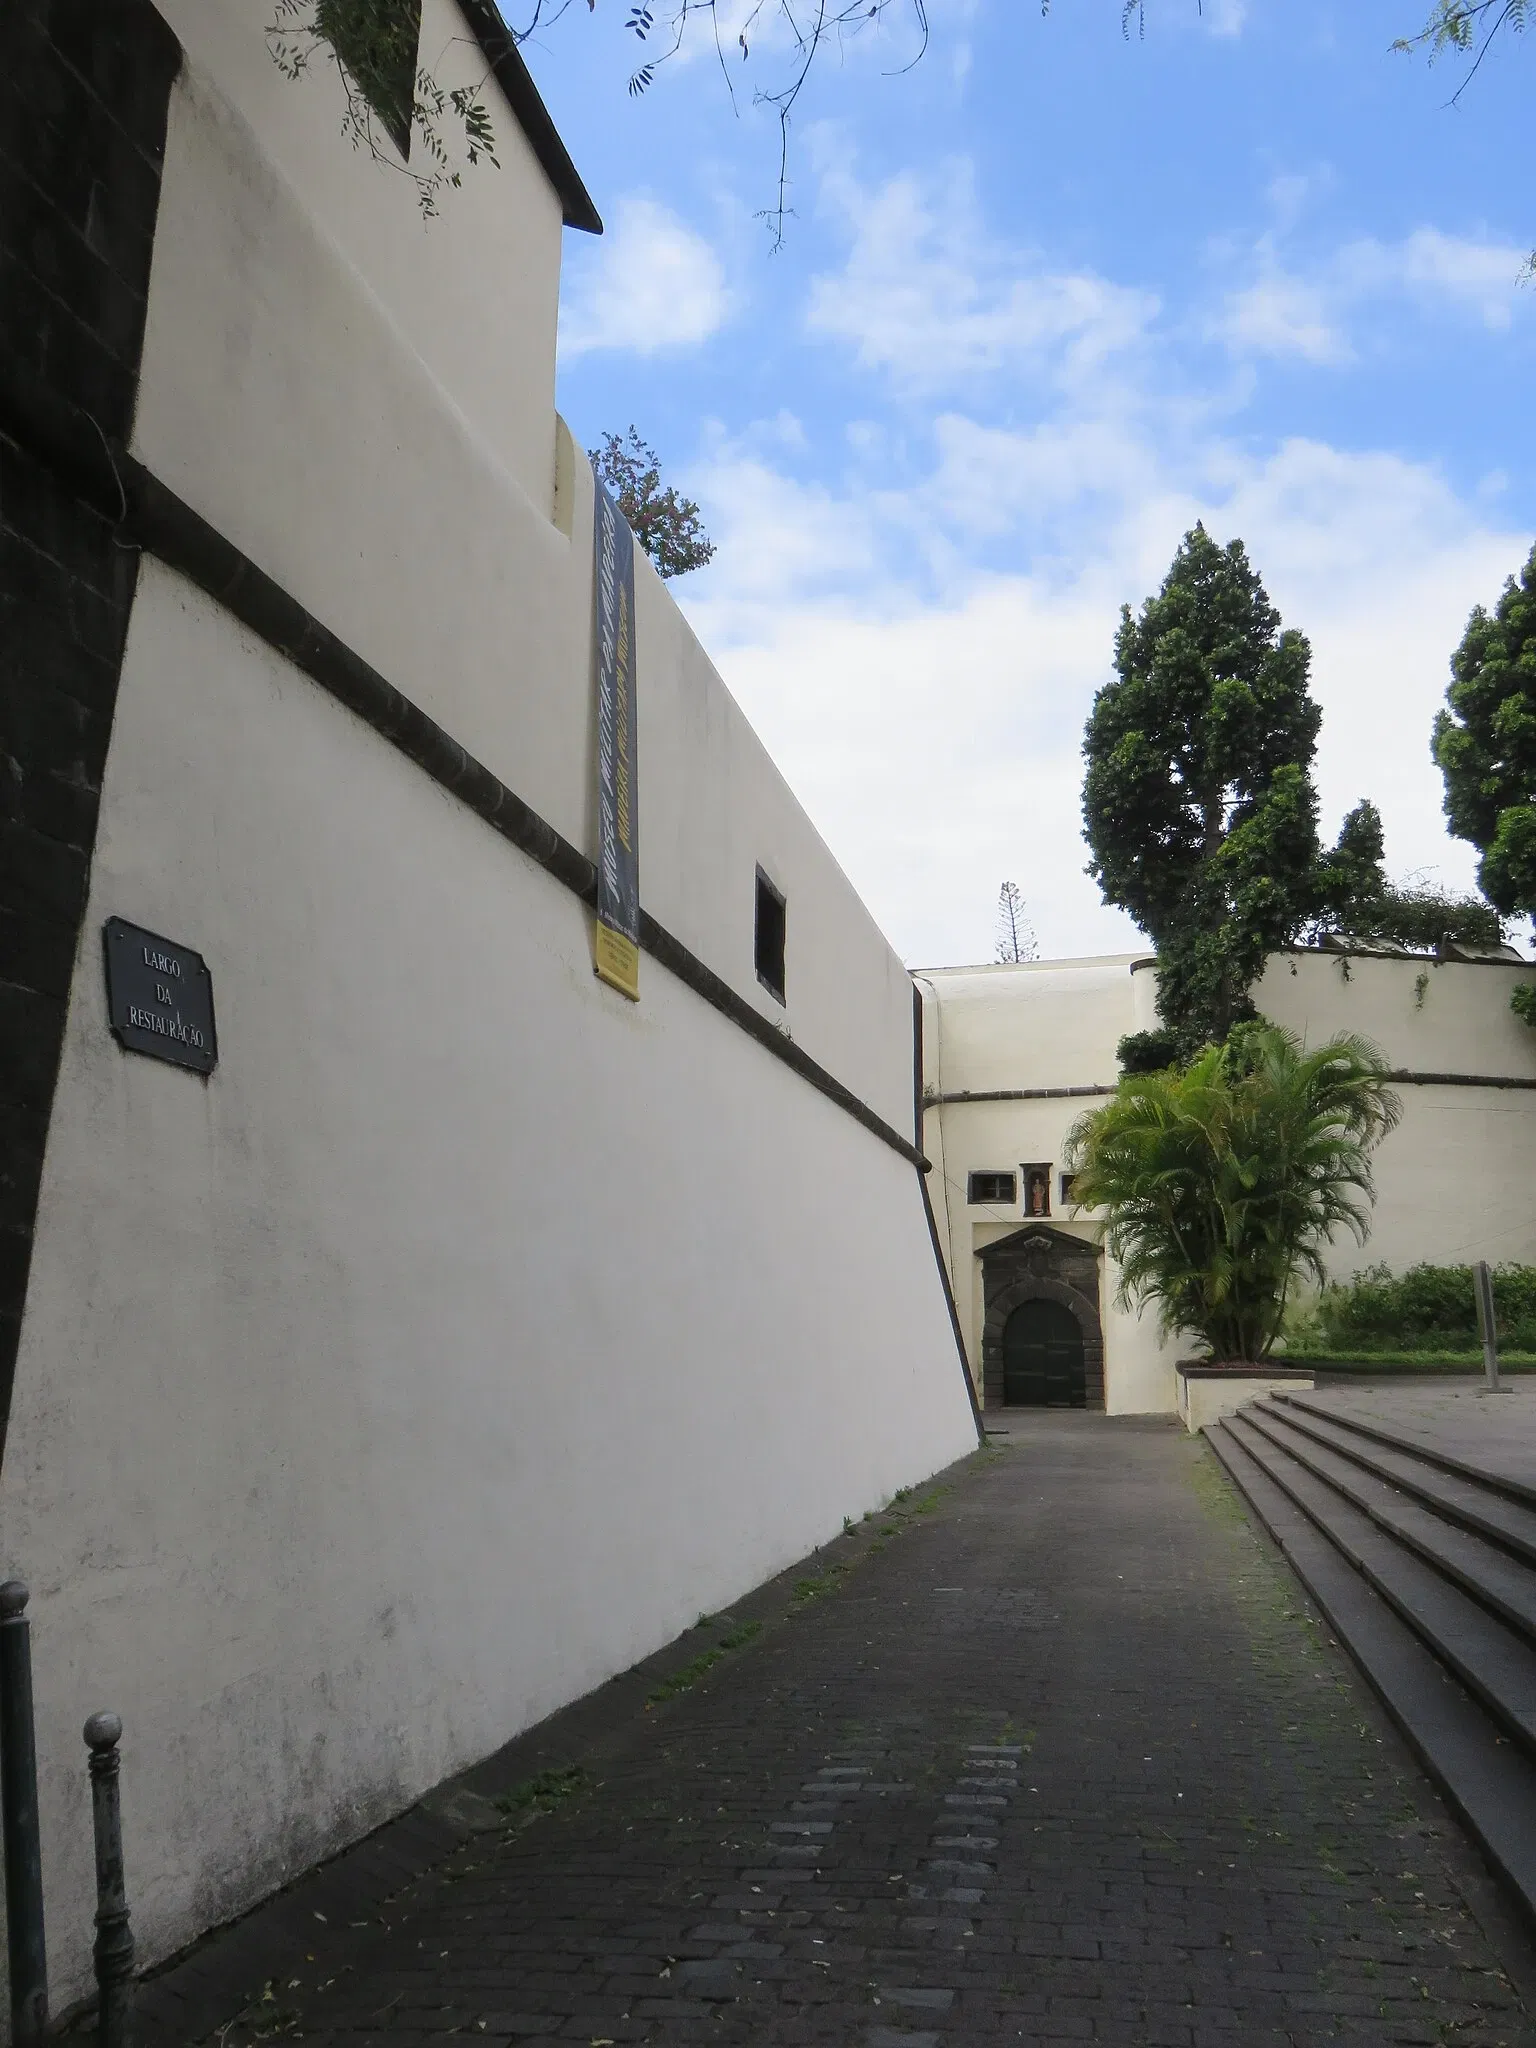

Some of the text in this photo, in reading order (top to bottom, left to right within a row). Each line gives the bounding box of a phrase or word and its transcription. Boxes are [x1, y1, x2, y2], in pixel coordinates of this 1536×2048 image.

[602, 791, 620, 903] MUSEU
[144, 947, 180, 978] LARGO
[156, 983, 172, 1005] DA
[129, 1005, 204, 1048] RESTAURAÇÃO
